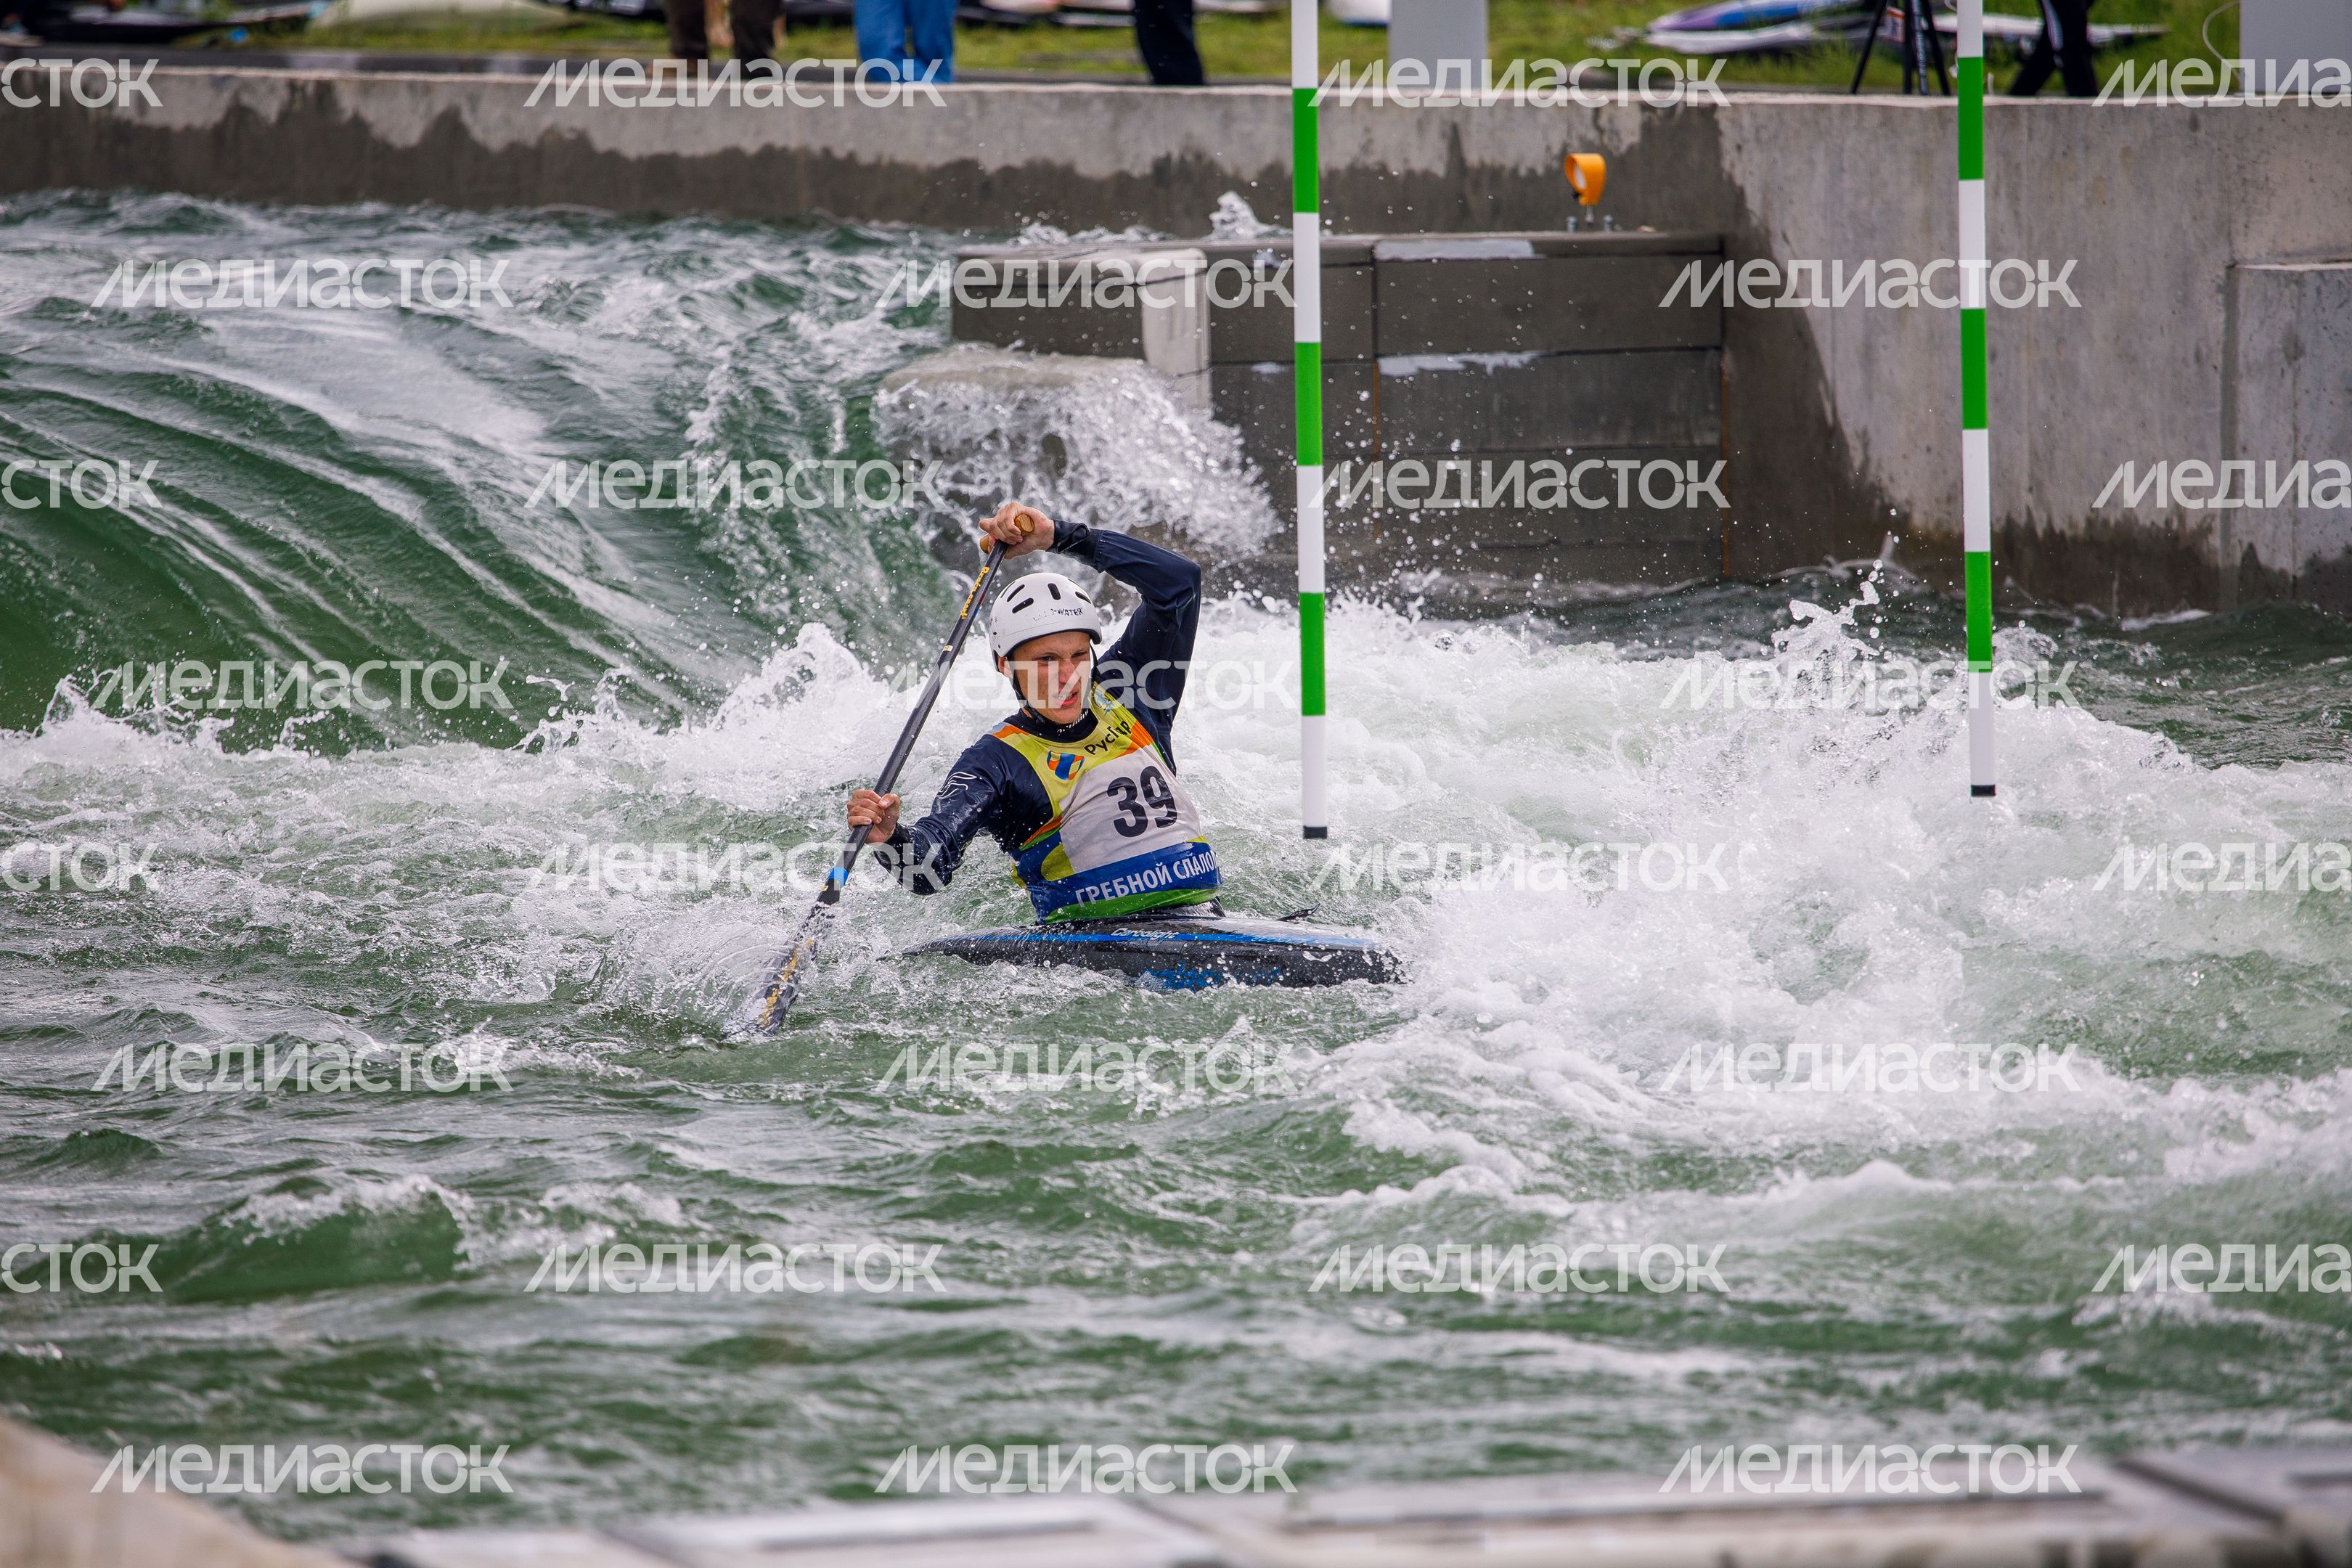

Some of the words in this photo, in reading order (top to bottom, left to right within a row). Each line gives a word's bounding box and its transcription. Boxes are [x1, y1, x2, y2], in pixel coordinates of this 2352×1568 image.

[1106, 765, 1178, 838] 39
[1075, 862, 1173, 908] ГРЕБНОЙ
[1110, 927, 1180, 940] Carbolight
